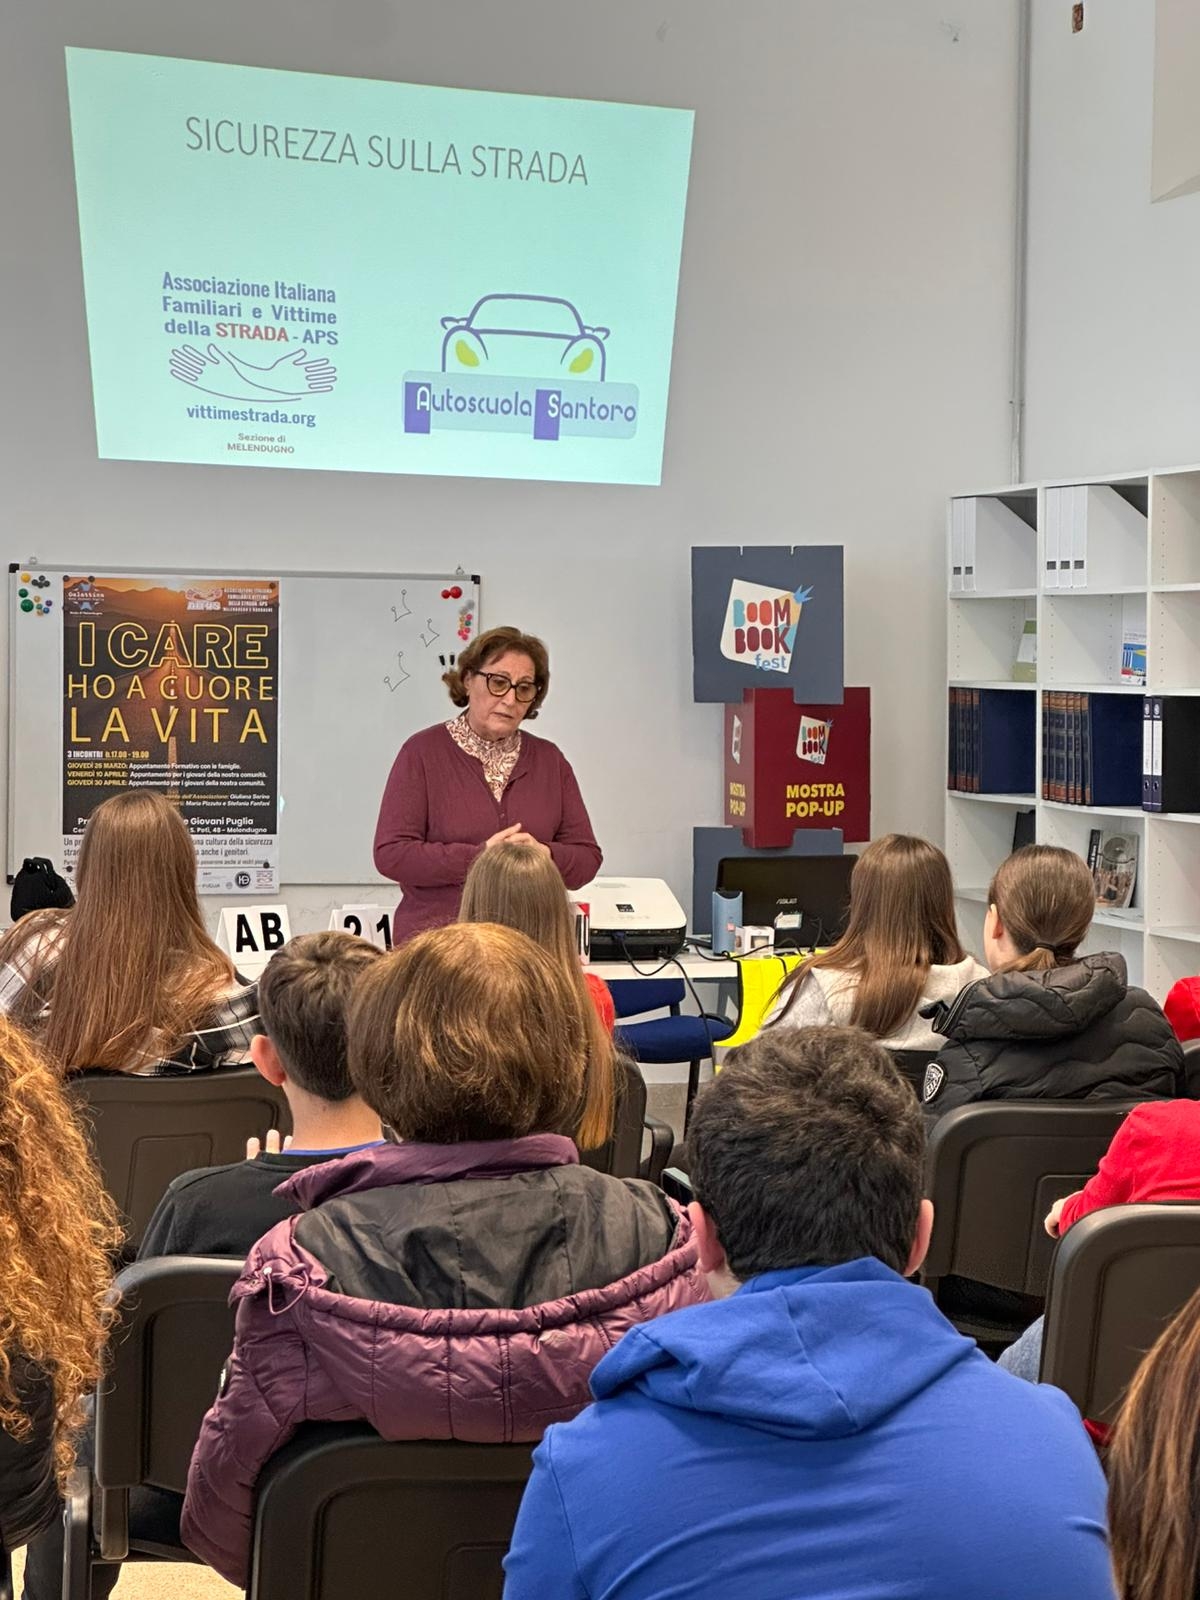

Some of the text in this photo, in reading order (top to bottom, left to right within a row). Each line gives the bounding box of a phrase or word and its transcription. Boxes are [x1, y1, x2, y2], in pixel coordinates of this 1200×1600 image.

[186, 116, 588, 186] SICUREZZA SULLA STRADA
[162, 271, 336, 303] Associazione Italiana
[162, 296, 337, 325] Familiari e Vittime
[164, 319, 211, 336] della
[215, 322, 289, 342] STRADA
[302, 329, 339, 346] APS
[416, 386, 637, 422] Autoscuola Santoro
[186, 405, 316, 428] vittimestrada.org
[238, 433, 286, 443] Sezione di
[227, 442, 295, 454] MELENDUGNO
[733, 598, 791, 627] BOOM
[79, 622, 269, 669] I CARE
[735, 626, 791, 654] BOOK
[755, 653, 787, 671] fest
[68, 674, 273, 700] HO A CUORE
[70, 706, 268, 744] LA VITA
[67, 750, 72, 758] 3
[73, 750, 103, 758] INCONTRI
[129, 762, 170, 770] Appuntamento
[130, 771, 171, 779] Appuntamento
[186, 771, 206, 779] giovani
[128, 779, 170, 788] Appuntamento
[185, 780, 204, 788] giovani
[786, 783, 845, 799] MOSTRA
[786, 800, 845, 818] POP-UP
[190, 816, 224, 825] Giovani
[226, 816, 254, 826] Puglia
[227, 827, 267, 835] Melendugno
[205, 837, 228, 846] cultura
[228, 837, 244, 846] della
[245, 838, 273, 846] sicurezza
[201, 847, 219, 856] anche
[236, 912, 285, 953] AB
